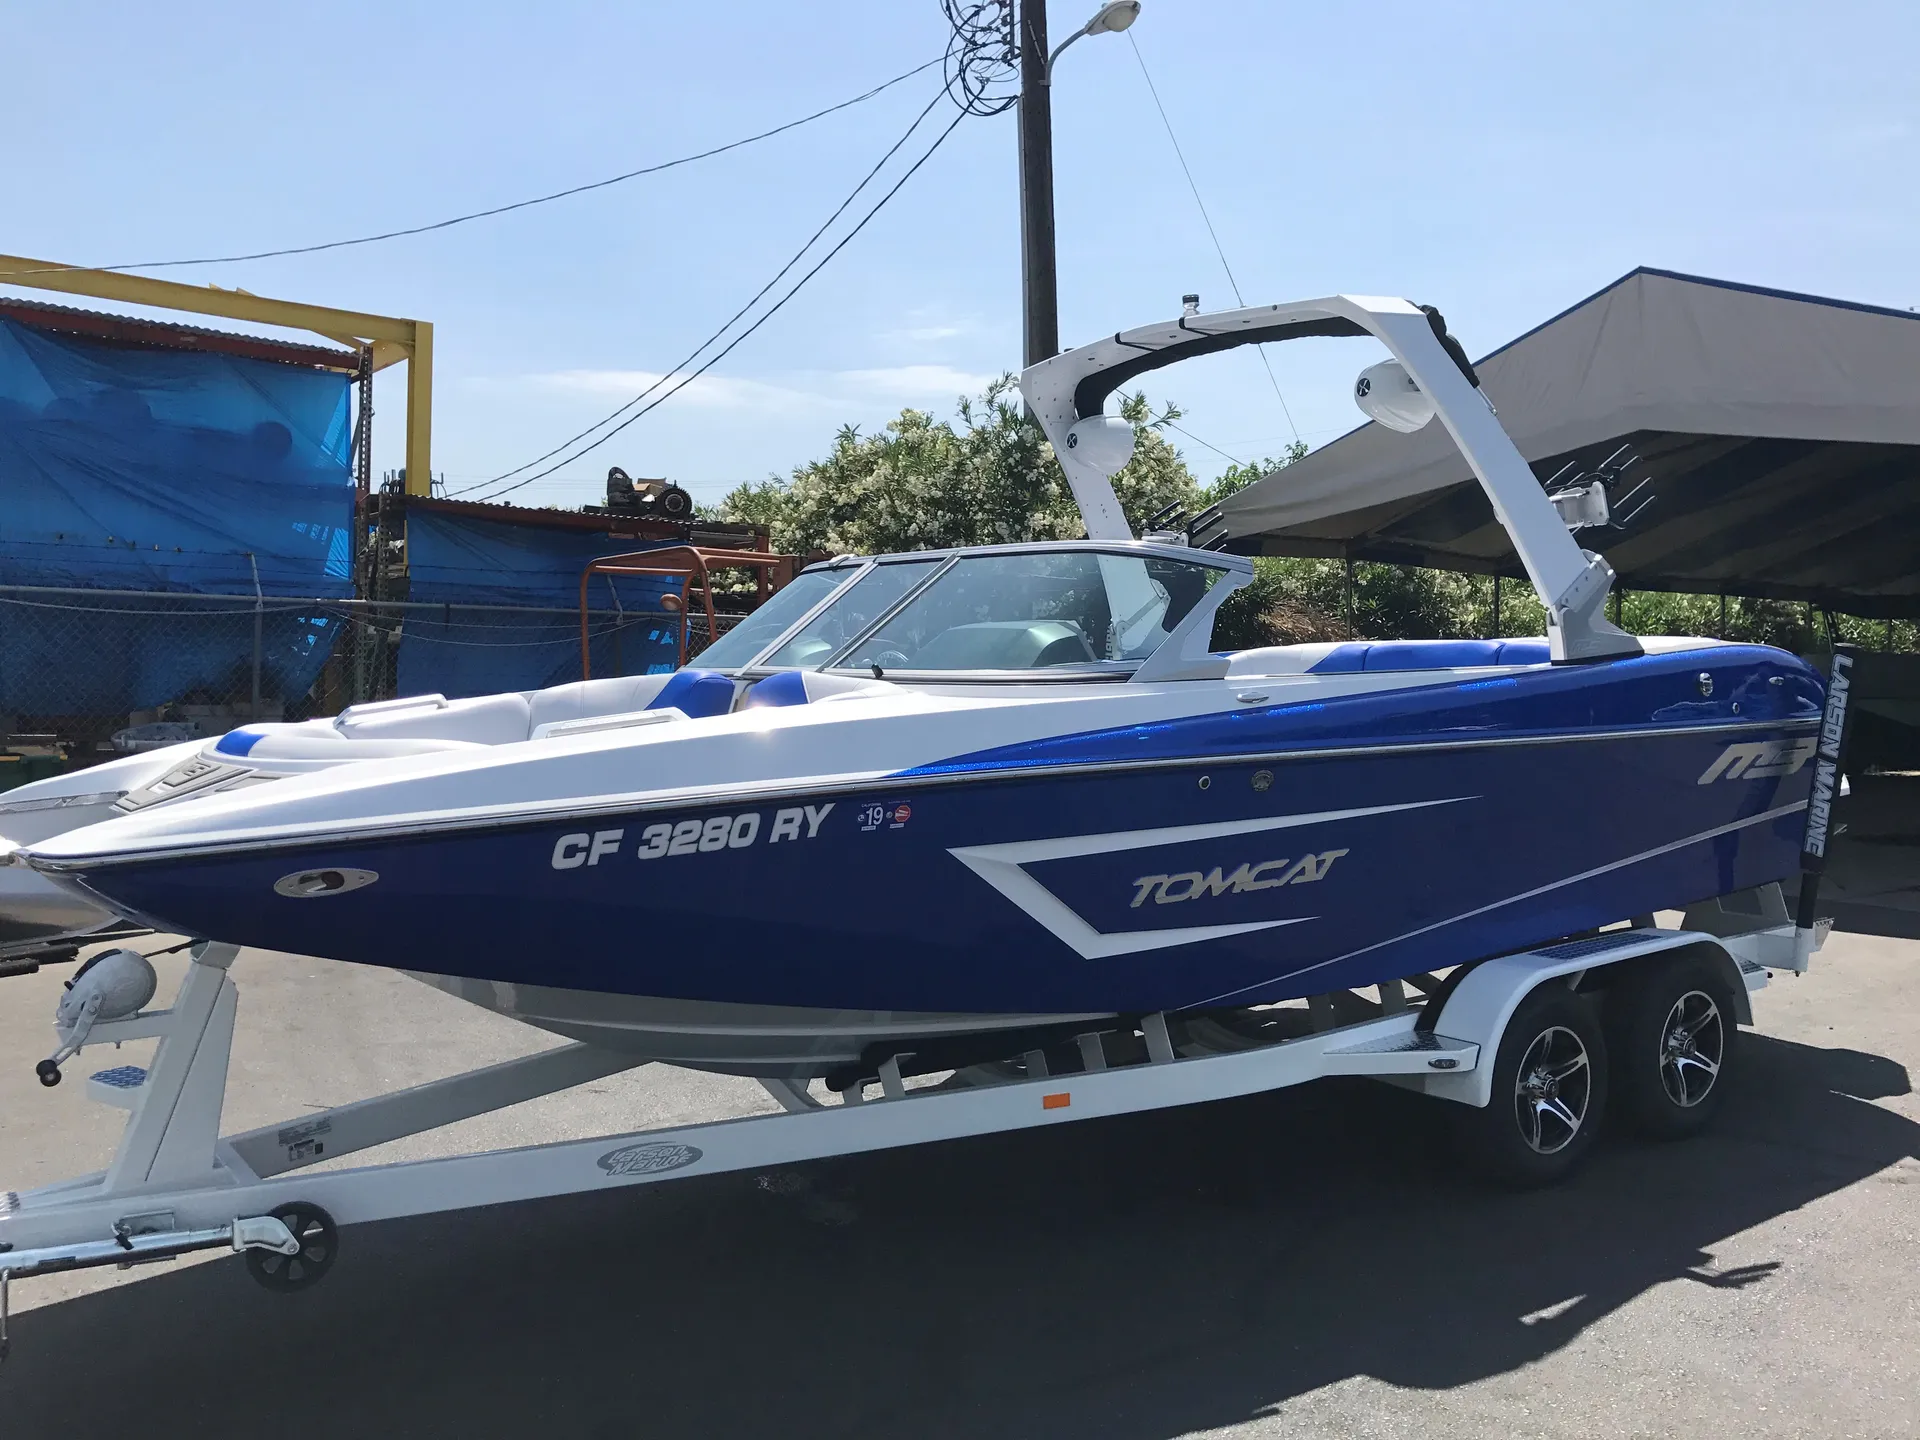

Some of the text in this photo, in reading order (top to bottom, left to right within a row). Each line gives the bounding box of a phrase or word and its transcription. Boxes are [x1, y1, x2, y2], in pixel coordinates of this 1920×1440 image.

[1803, 653, 1853, 858] LARSON MARINE
[551, 802, 836, 870] CF 3280 RY
[866, 806, 884, 826] 19
[1129, 847, 1350, 908] TOMCAT
